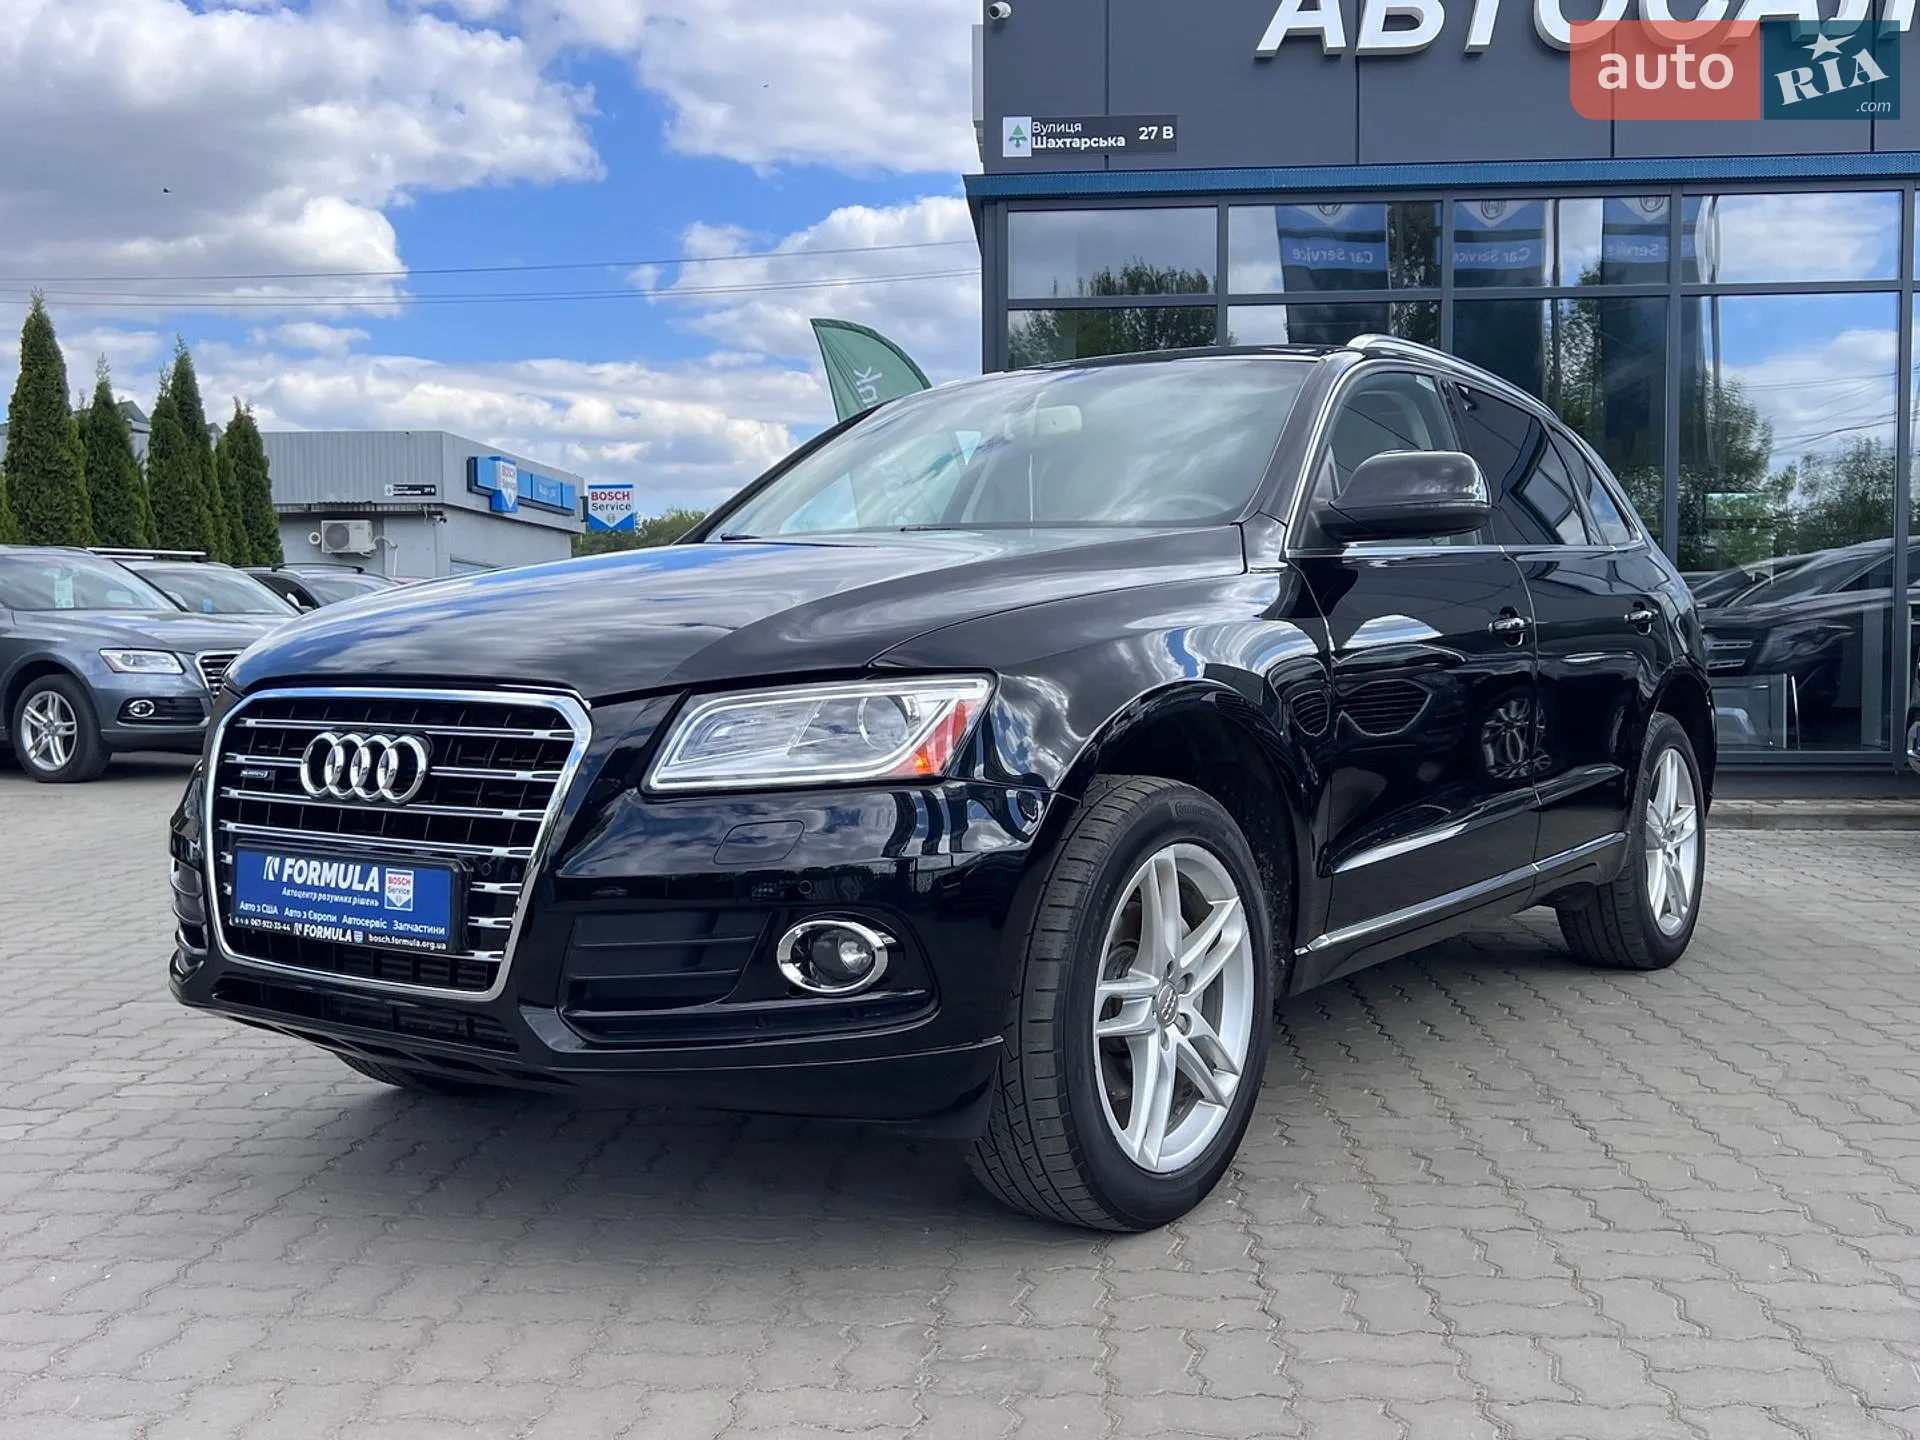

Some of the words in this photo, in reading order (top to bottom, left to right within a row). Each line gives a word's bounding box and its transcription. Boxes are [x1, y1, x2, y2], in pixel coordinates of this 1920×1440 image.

[1032, 121, 1082, 135] Вулиця
[1138, 126, 1158, 140] 27
[1161, 126, 1175, 139] В
[1032, 134, 1126, 151] Шахтарська
[590, 491, 630, 501] BOSCH
[591, 502, 632, 512] Service
[282, 857, 380, 893] FORMULA
[388, 876, 411, 886] BOSCH
[387, 885, 411, 895] Service
[239, 900, 256, 912] Авто
[261, 903, 279, 915] США
[284, 907, 302, 918] Авто
[308, 910, 337, 923] Європи
[342, 914, 388, 930] Автосервіс
[392, 919, 446, 936] Запчастини
[303, 924, 352, 943] FORMULA
